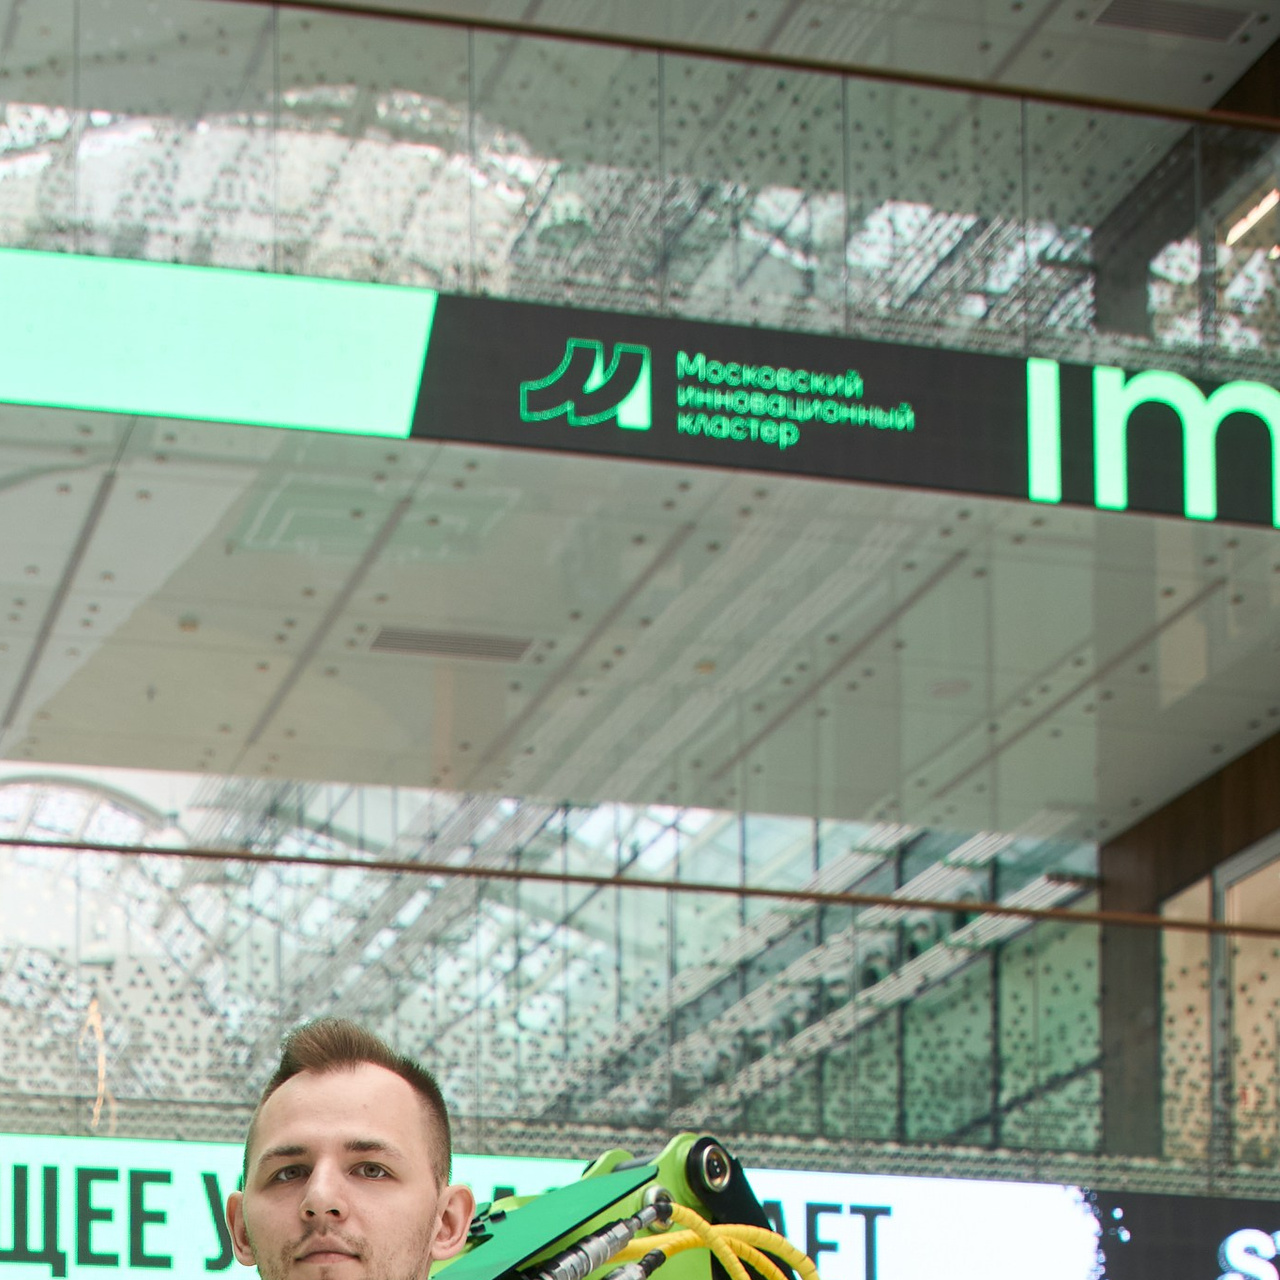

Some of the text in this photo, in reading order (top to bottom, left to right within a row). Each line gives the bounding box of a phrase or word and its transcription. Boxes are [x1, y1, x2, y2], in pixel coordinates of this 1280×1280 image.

[676, 350, 863, 398] Московский
[676, 384, 915, 431] инновационный
[676, 412, 800, 450] кластер
